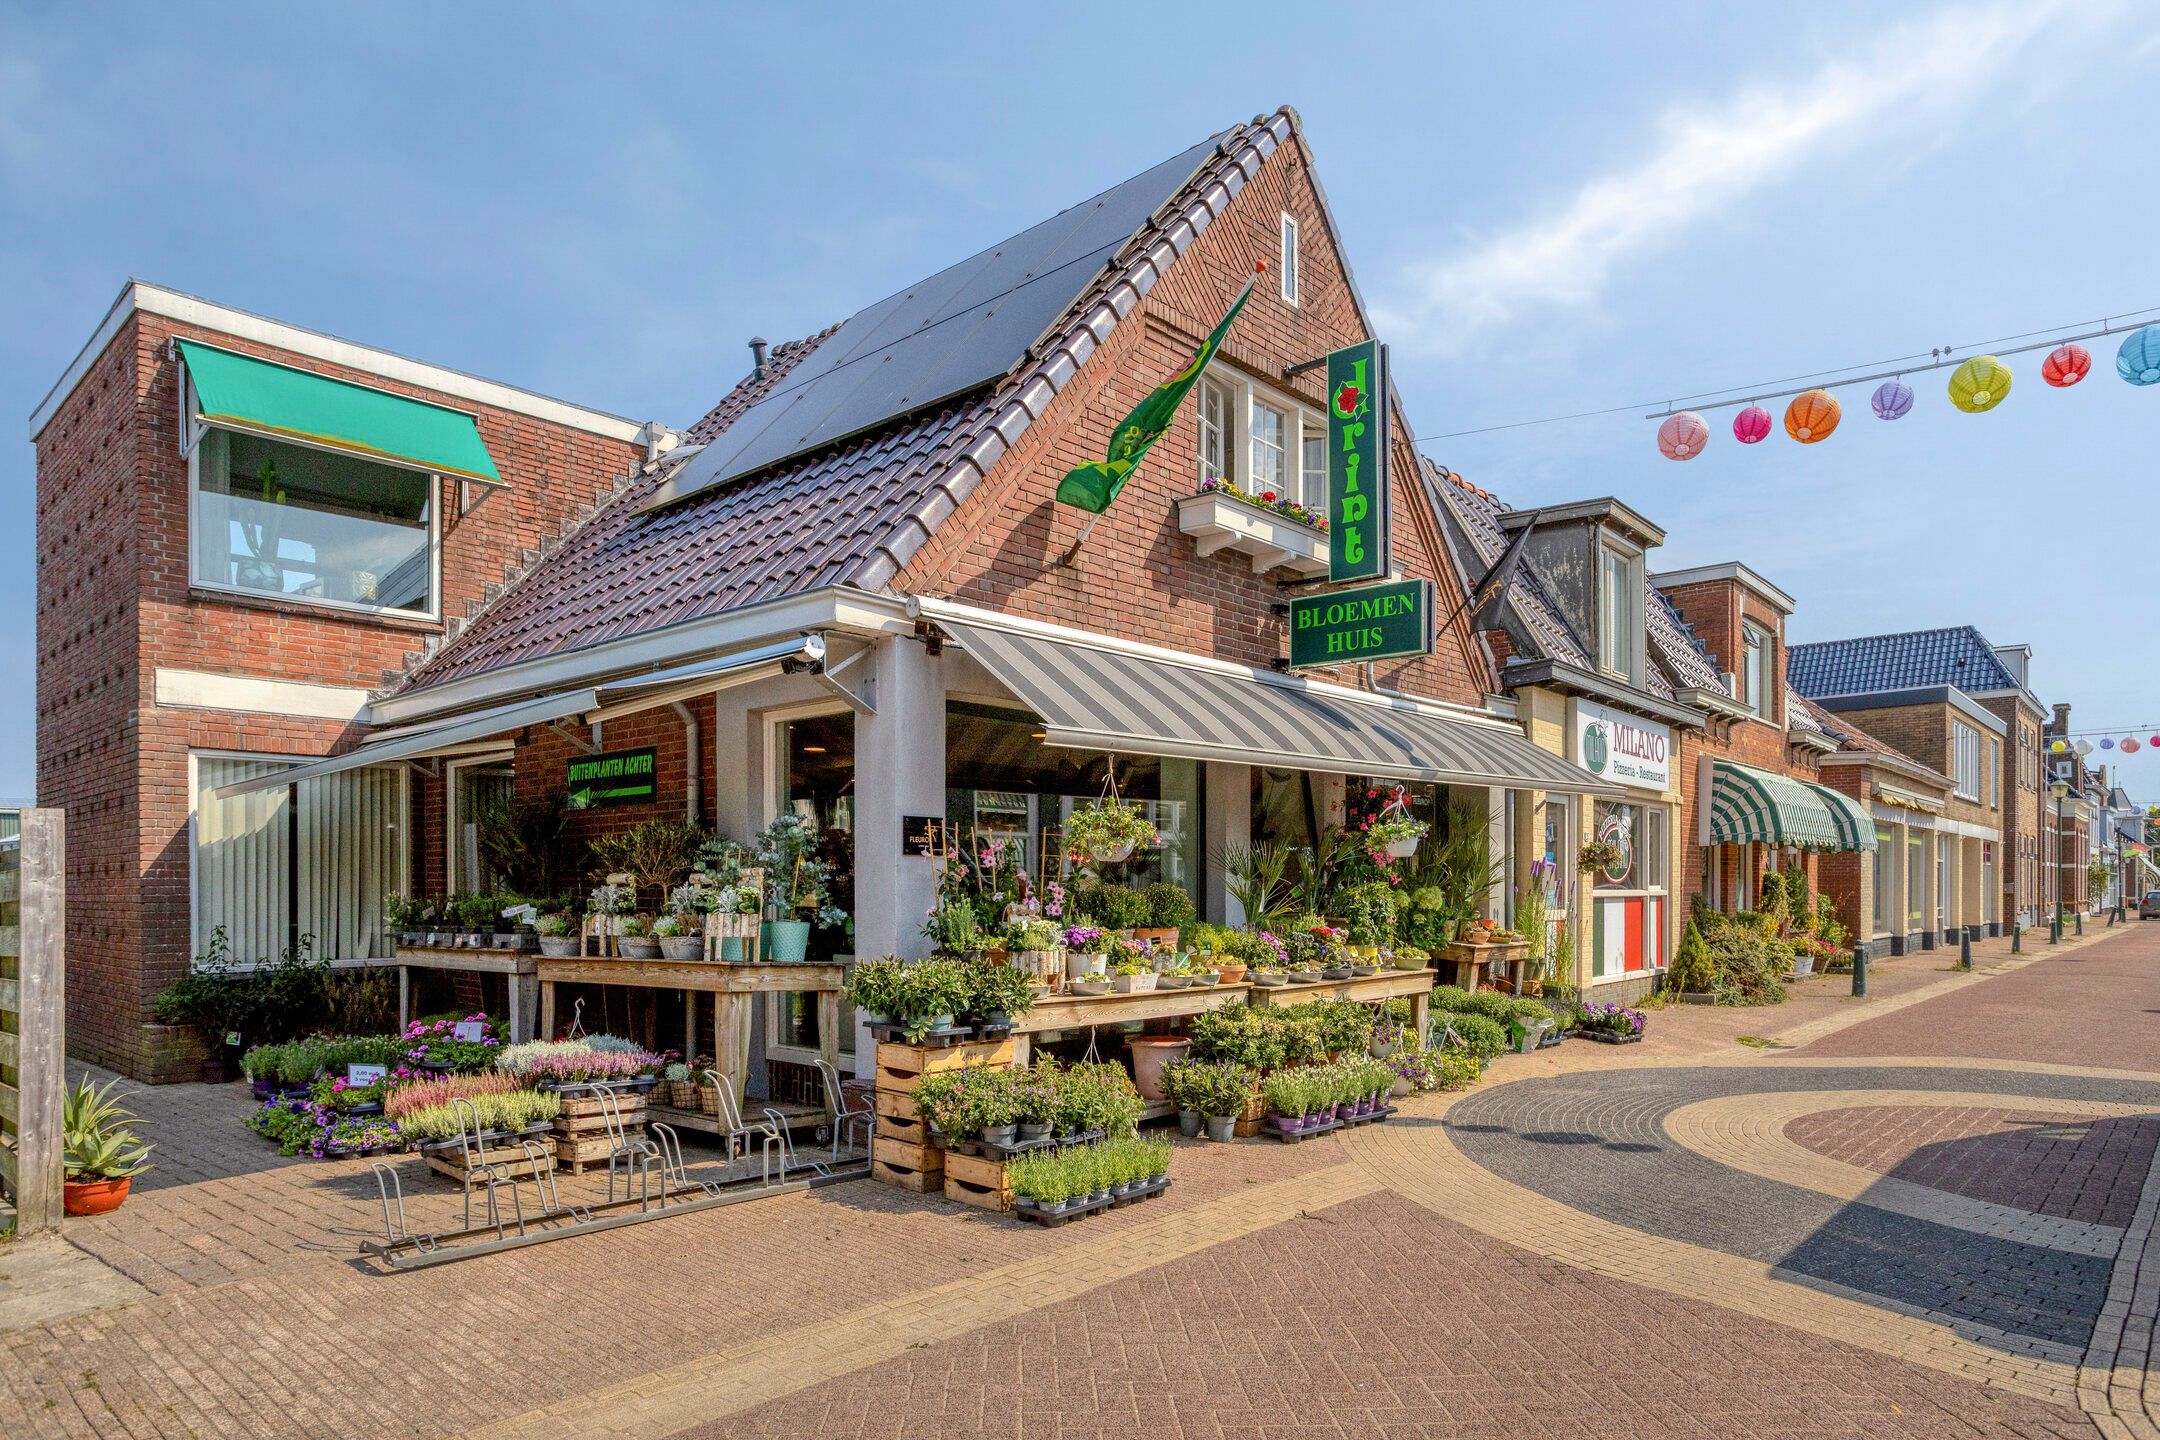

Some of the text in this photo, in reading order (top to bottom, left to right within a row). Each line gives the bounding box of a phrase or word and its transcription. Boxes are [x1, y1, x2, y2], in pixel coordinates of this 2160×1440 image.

[1297, 592, 1415, 629] BLOEMEN
[1327, 626, 1383, 653] HUIS
[1613, 721, 1665, 764] MILANO
[569, 754, 652, 781] BUITENPLANTEN ACHTER
[1613, 760, 1636, 777] Pizzeria
[1639, 766, 1666, 783] Restaurant
